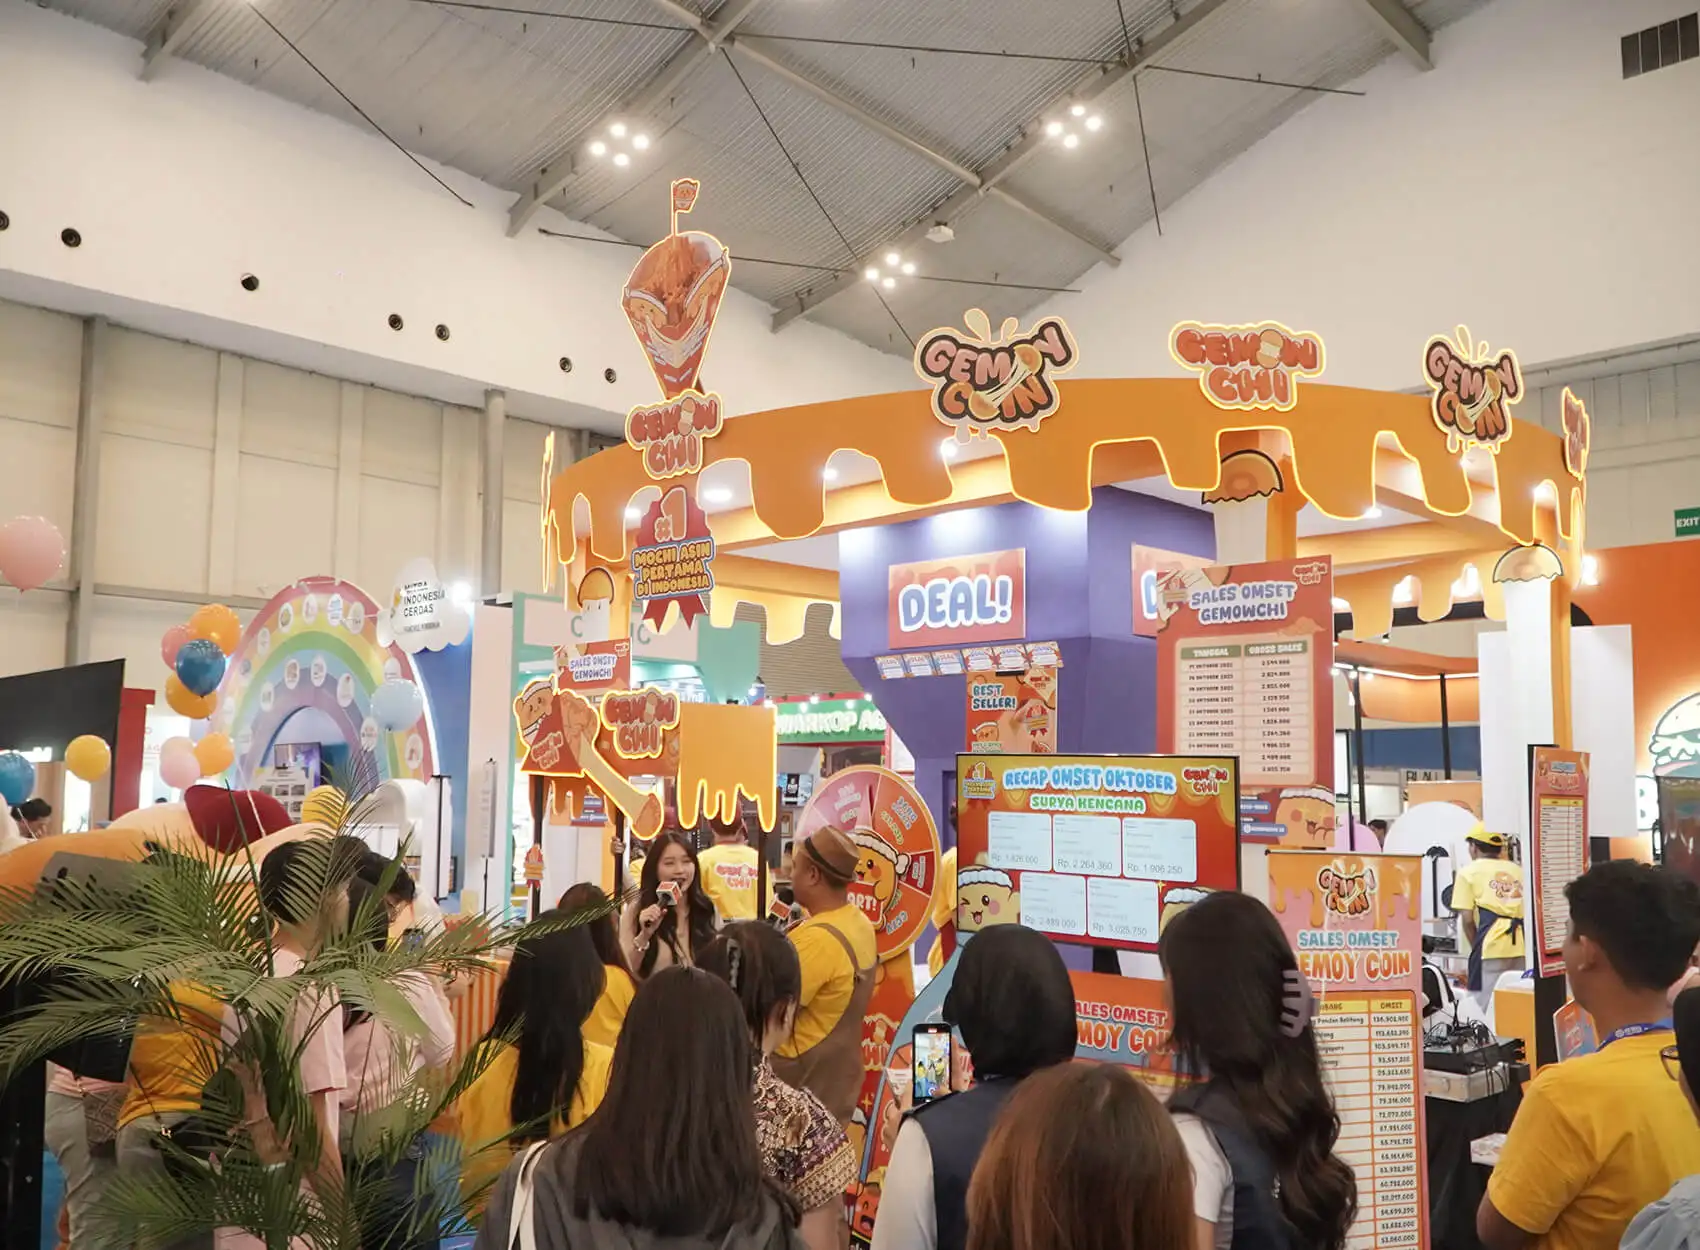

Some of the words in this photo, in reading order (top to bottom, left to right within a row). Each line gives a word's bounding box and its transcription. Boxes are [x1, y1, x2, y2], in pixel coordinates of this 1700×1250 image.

[1676, 516, 1700, 528] EXIT
[635, 546, 677, 568] MOCHI
[680, 541, 711, 560] ASIN
[642, 560, 704, 581] PERTAMA
[652, 574, 710, 595] INDONESIA
[1192, 585, 1236, 606] SALES
[1241, 583, 1295, 600] OMSET
[404, 590, 445, 605] INDONESIA
[901, 576, 1012, 629] DEAL!
[403, 604, 433, 617] CERDAS
[1200, 602, 1286, 621] GEMOWCHI
[570, 656, 591, 669] SALES
[574, 668, 612, 680] GEMOWCHI
[973, 684, 1002, 696] BEST
[973, 697, 1016, 709] SELLER!
[777, 710, 858, 733] WARKOP
[1005, 769, 1048, 786] RECAP
[1052, 767, 1101, 788] OMSET
[1105, 770, 1175, 791] OKTOBER
[1032, 795, 1074, 808] SURYA
[1078, 798, 1145, 811] KENCANA
[1299, 932, 1344, 947] SALES
[1348, 932, 1397, 947] OMSET
[1300, 952, 1359, 981] EMOY
[1365, 951, 1411, 979] COIN
[1076, 1001, 1108, 1018] ALES
[1113, 1006, 1166, 1025] OMSET
[1077, 1020, 1124, 1050] MOY
